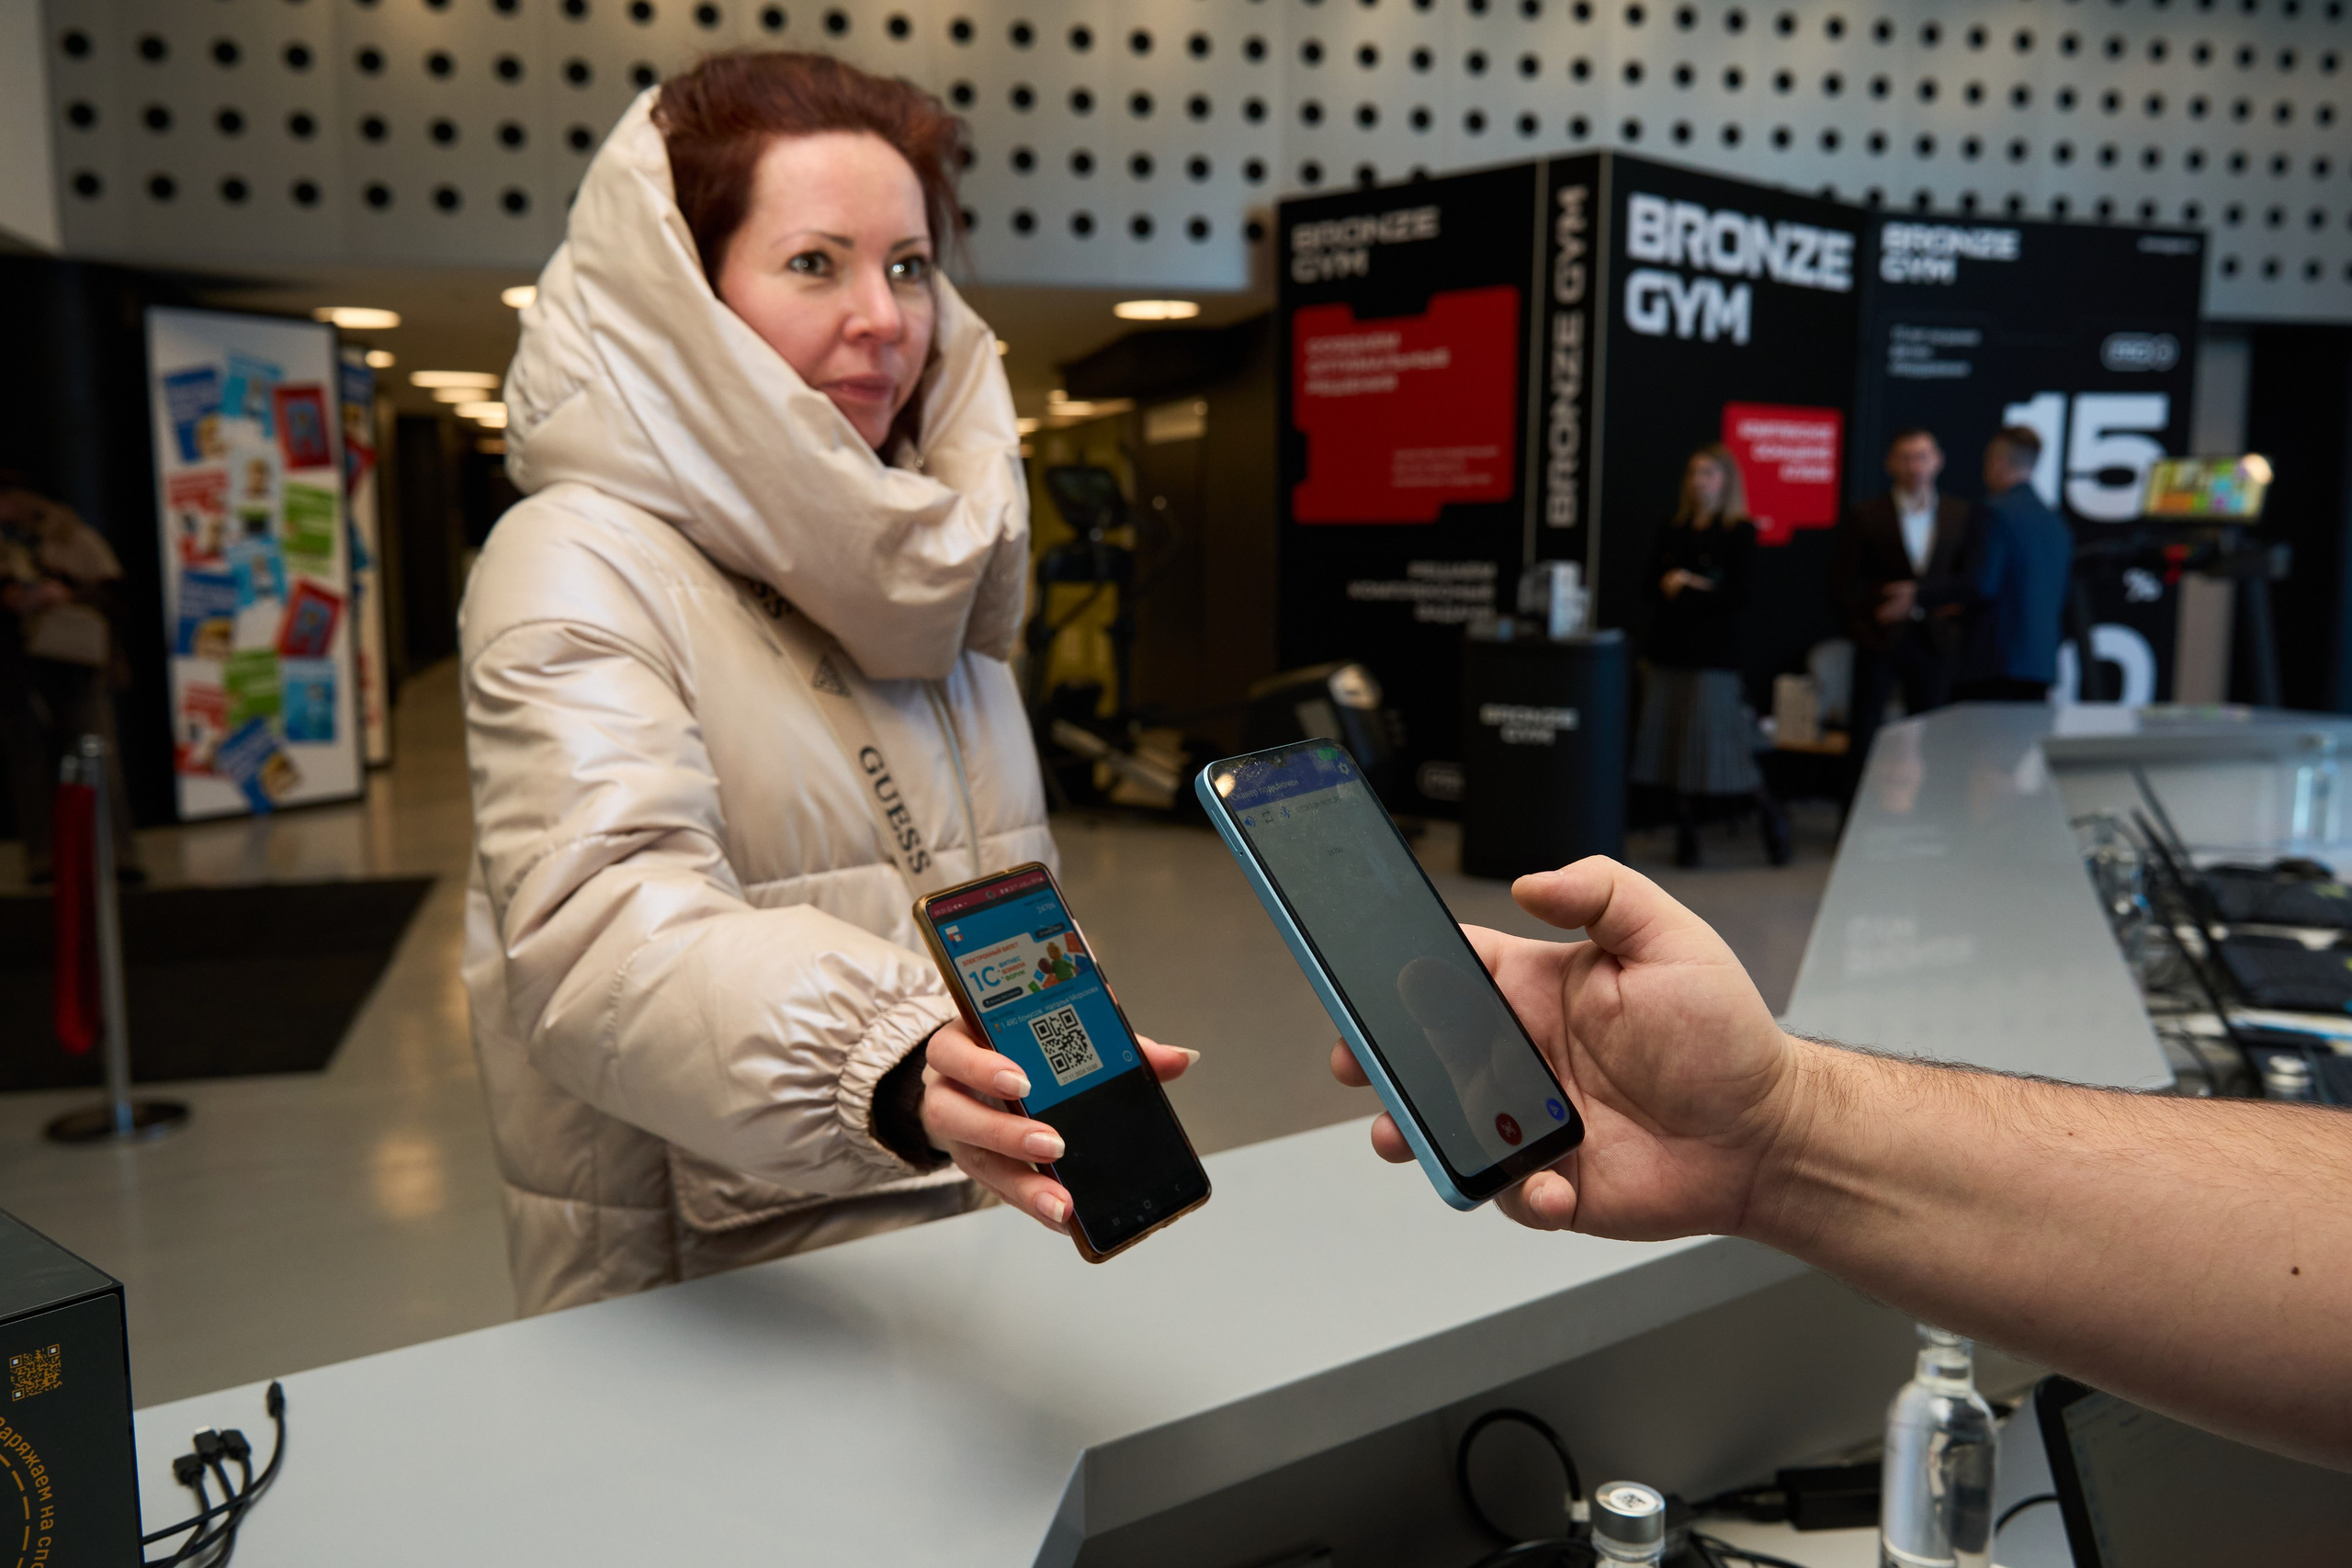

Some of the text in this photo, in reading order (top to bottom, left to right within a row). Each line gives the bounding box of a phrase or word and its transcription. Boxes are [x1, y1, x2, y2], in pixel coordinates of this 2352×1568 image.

[1290, 206, 1442, 248] BRONZE
[1291, 248, 1370, 284] GYM
[1627, 192, 1855, 292] BRONZE
[1624, 267, 1754, 346] GYM
[1546, 185, 1589, 529] BRONZE GYM
[2004, 391, 2170, 523] 15
[859, 745, 931, 874] GUESS
[1230, 777, 1298, 803] Сканер подключен
[40, 1506, 54, 1531] на
